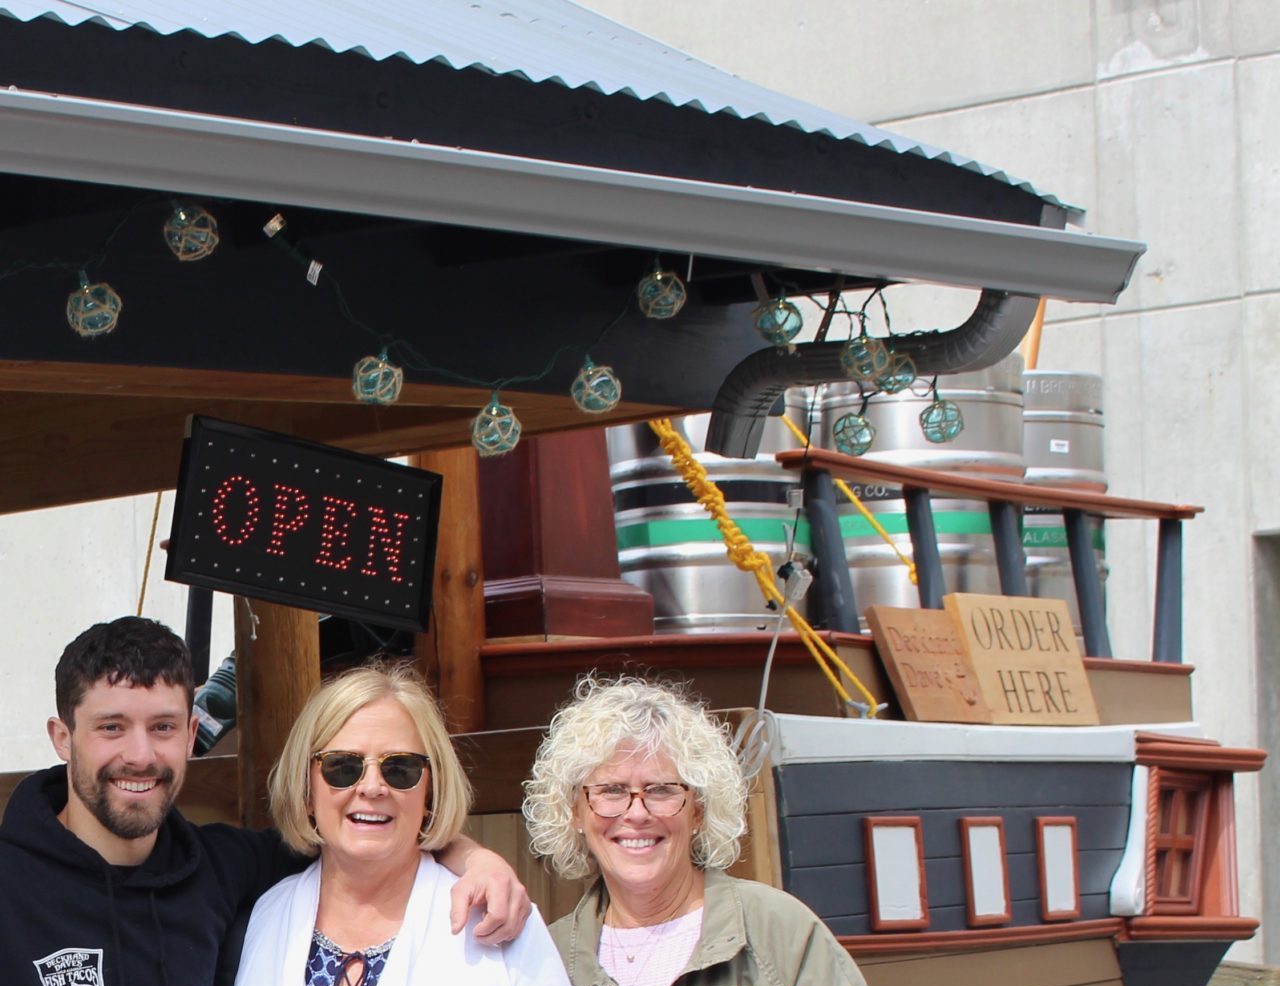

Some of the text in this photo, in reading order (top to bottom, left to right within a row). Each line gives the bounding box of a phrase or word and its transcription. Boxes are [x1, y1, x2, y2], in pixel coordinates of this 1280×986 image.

[212, 476, 410, 582] OPEN
[971, 607, 1070, 653] ORDER
[997, 669, 1078, 713] HERE
[46, 953, 90, 968] DECKHAND
[54, 959, 83, 973] DAVES
